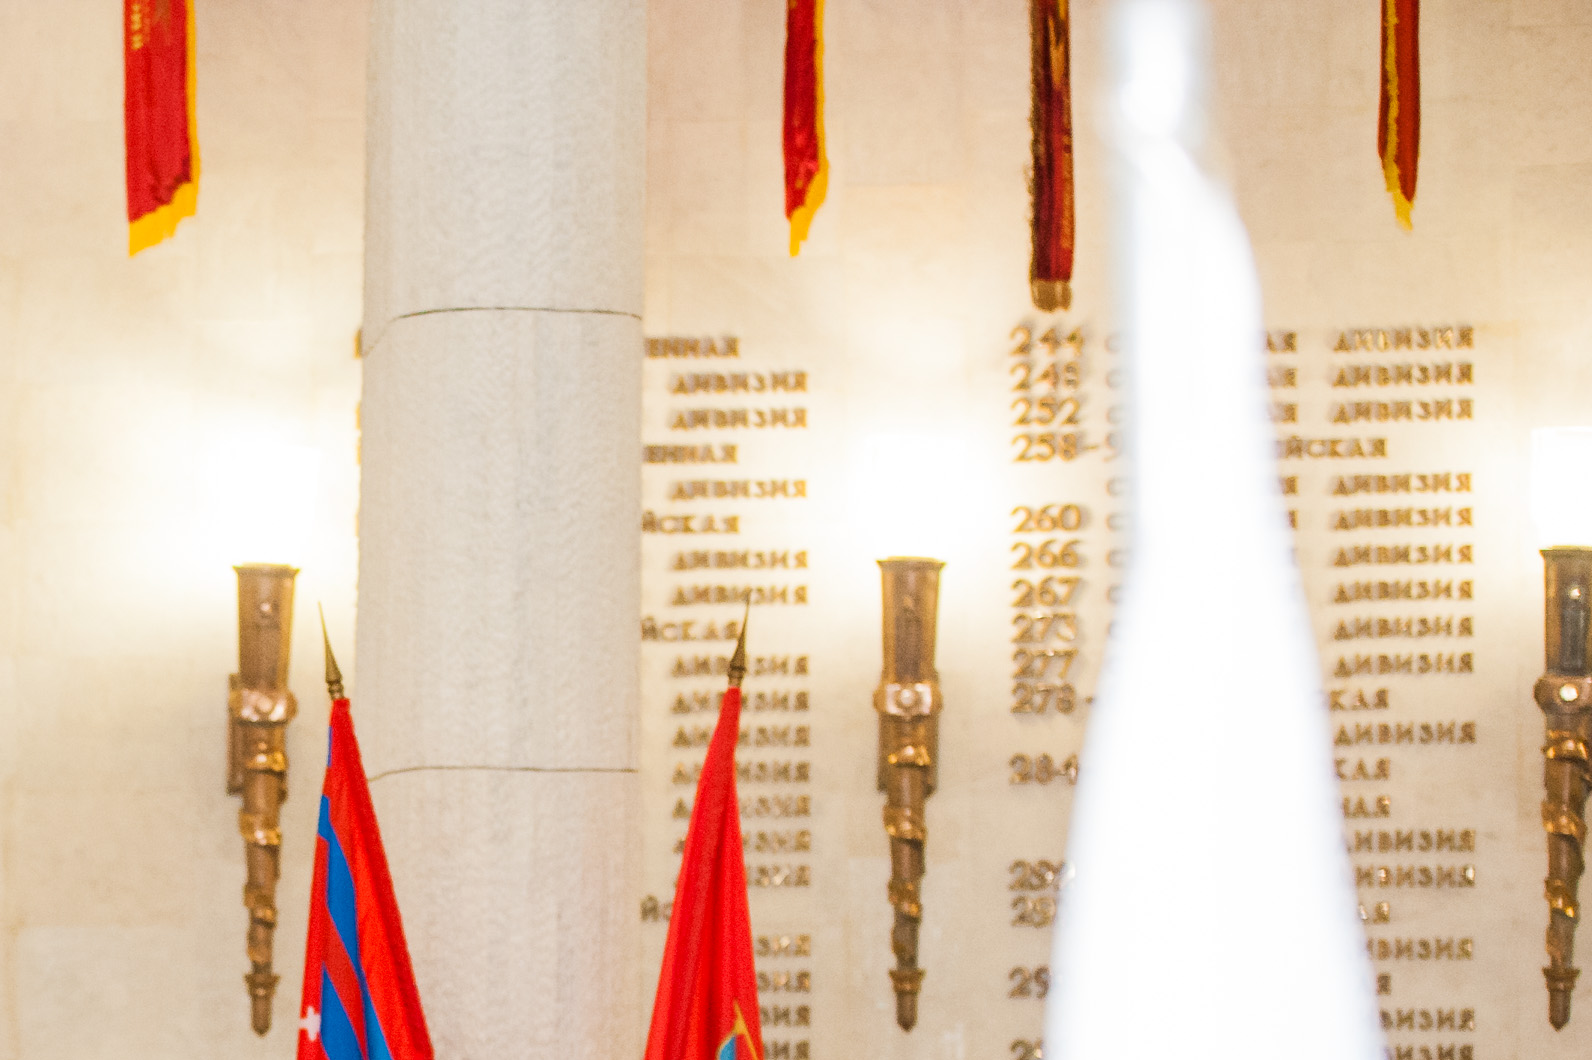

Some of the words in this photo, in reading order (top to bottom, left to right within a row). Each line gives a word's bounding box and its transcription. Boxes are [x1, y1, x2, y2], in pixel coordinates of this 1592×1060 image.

[1010, 325, 1084, 357] 244
[1332, 362, 1473, 388] ДИВИЗИЯ
[1010, 397, 1080, 426] 252
[1332, 399, 1473, 424] ДИВИЗИЯ
[1332, 473, 1472, 496] ДИВИЗИЯ
[1010, 503, 1082, 533] 260
[1333, 507, 1473, 531] ДИВИЗИЯ
[1010, 539, 1082, 570] 266
[1333, 544, 1473, 567] ДИВИЗИЯ
[1010, 576, 1082, 607] 267
[1333, 579, 1473, 603] ДИВИЗИЯ
[1333, 616, 1473, 640] ДИВИЗИЯ
[671, 656, 809, 677] ДИВЗИЯ
[1011, 648, 1079, 680] 277
[1333, 652, 1473, 677] ДИВИЗИЯ
[1334, 721, 1476, 746] ДИВИЗИЯ
